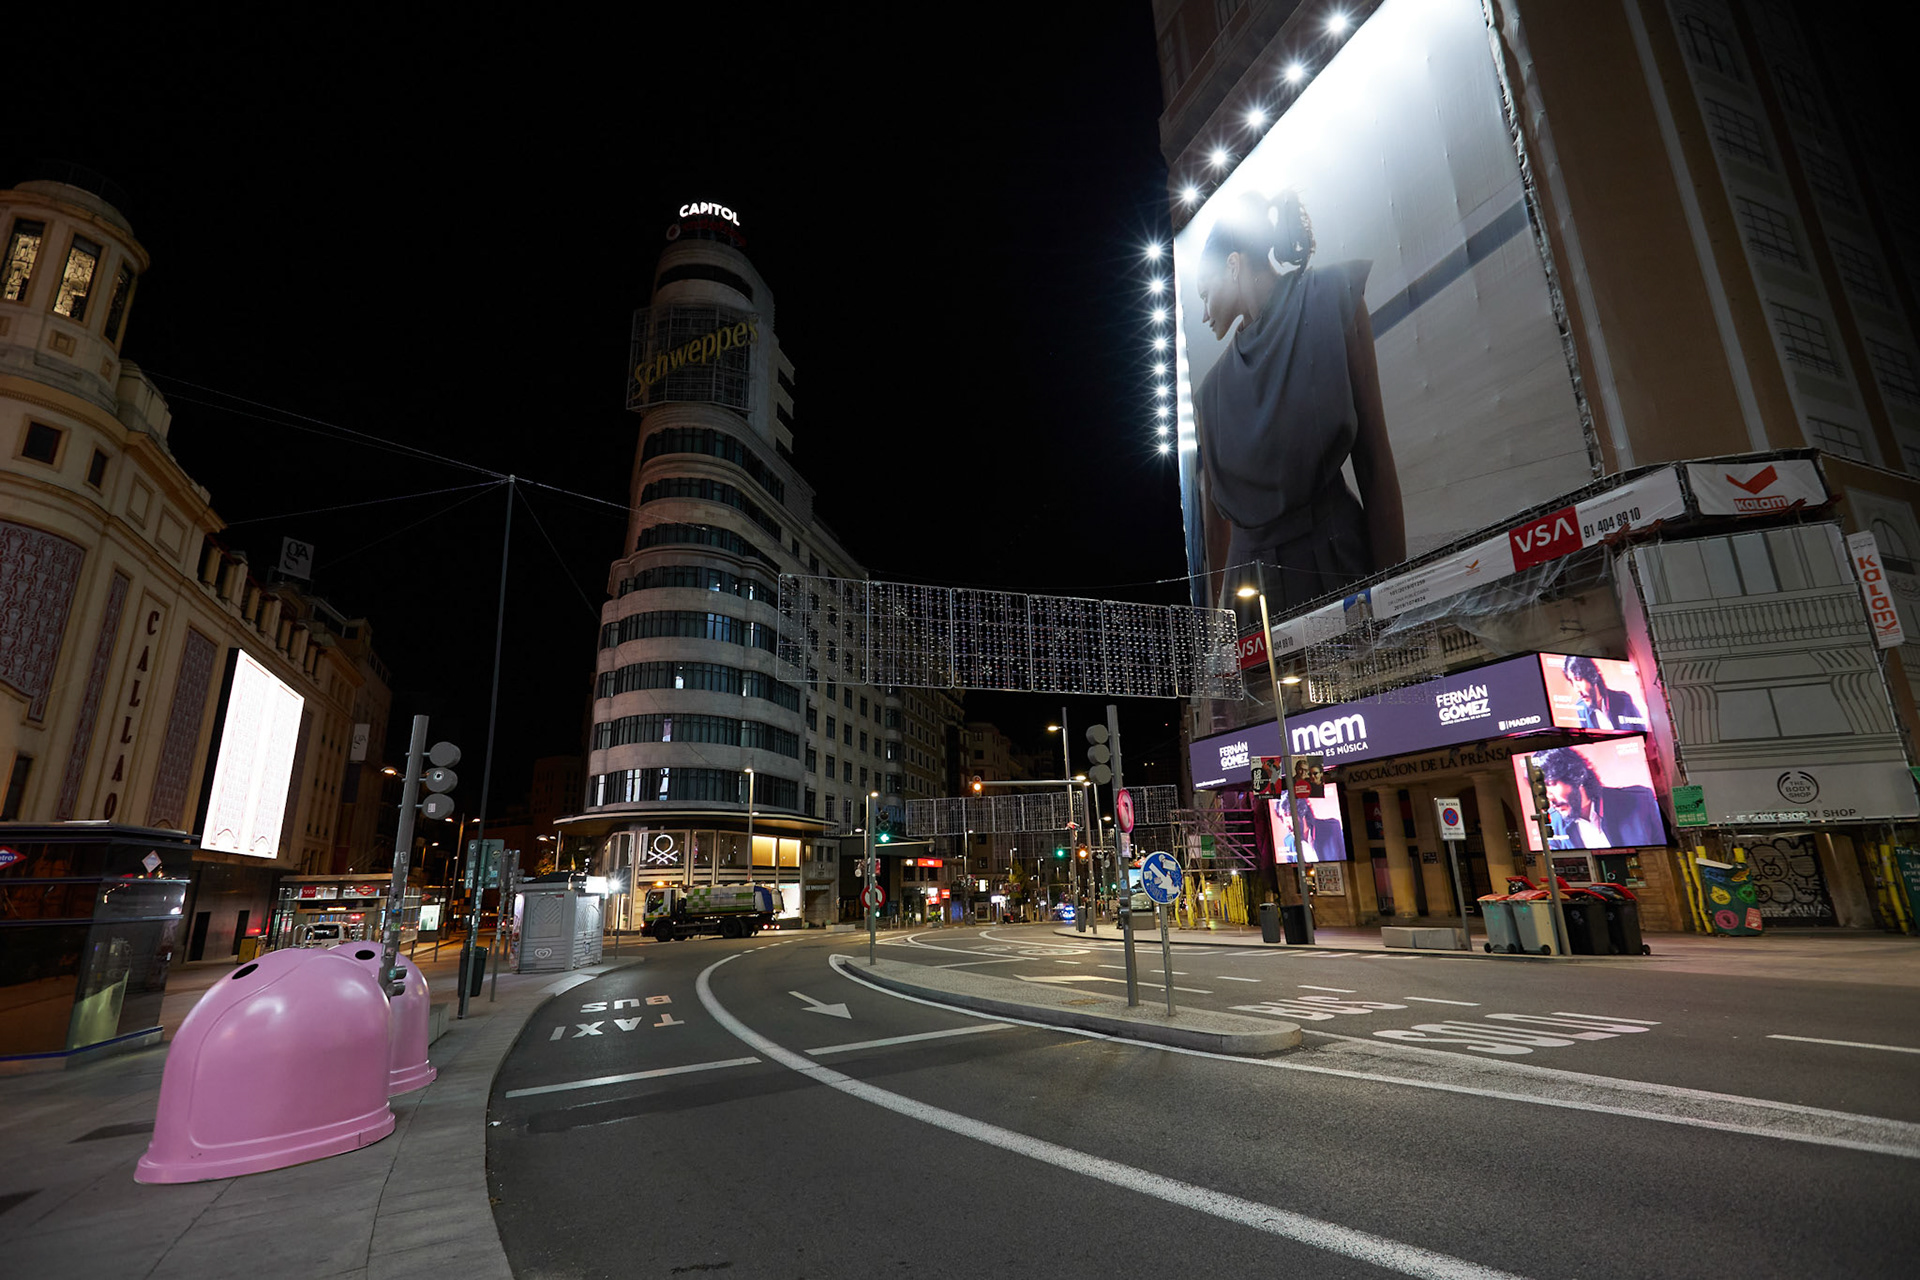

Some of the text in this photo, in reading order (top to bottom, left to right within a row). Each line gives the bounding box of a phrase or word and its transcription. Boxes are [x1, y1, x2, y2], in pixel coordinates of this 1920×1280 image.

[679, 202, 740, 226] CAPITOL
[630, 315, 760, 400] Schweppes
[1584, 507, 1641, 538] 91 404 89 10
[1514, 517, 1574, 553] VSA
[1436, 685, 1488, 708] FERNÁN
[104, 611, 160, 819] CALLAO
[1439, 699, 1491, 721] GÓMEZ
[1508, 715, 1541, 728] MADRID
[1291, 713, 1367, 753] mem
[1219, 741, 1248, 757] FERNÁN
[1221, 752, 1250, 768] GÓMEZ
[1326, 747, 1335, 757] ES
[1336, 741, 1369, 755] MÚSICA
[1348, 762, 1417, 783] ASOCIACION
[1421, 758, 1438, 772] DE
[1440, 755, 1458, 769] LA
[1460, 747, 1514, 766] PRENSA
[1778, 812, 1808, 821] SHOP
[1823, 809, 1856, 818] SHOP
[580, 995, 672, 1013] BUS
[1227, 996, 1408, 1021] BUS
[549, 1013, 685, 1041] TAXI
[1372, 1013, 1650, 1055] SOLO
